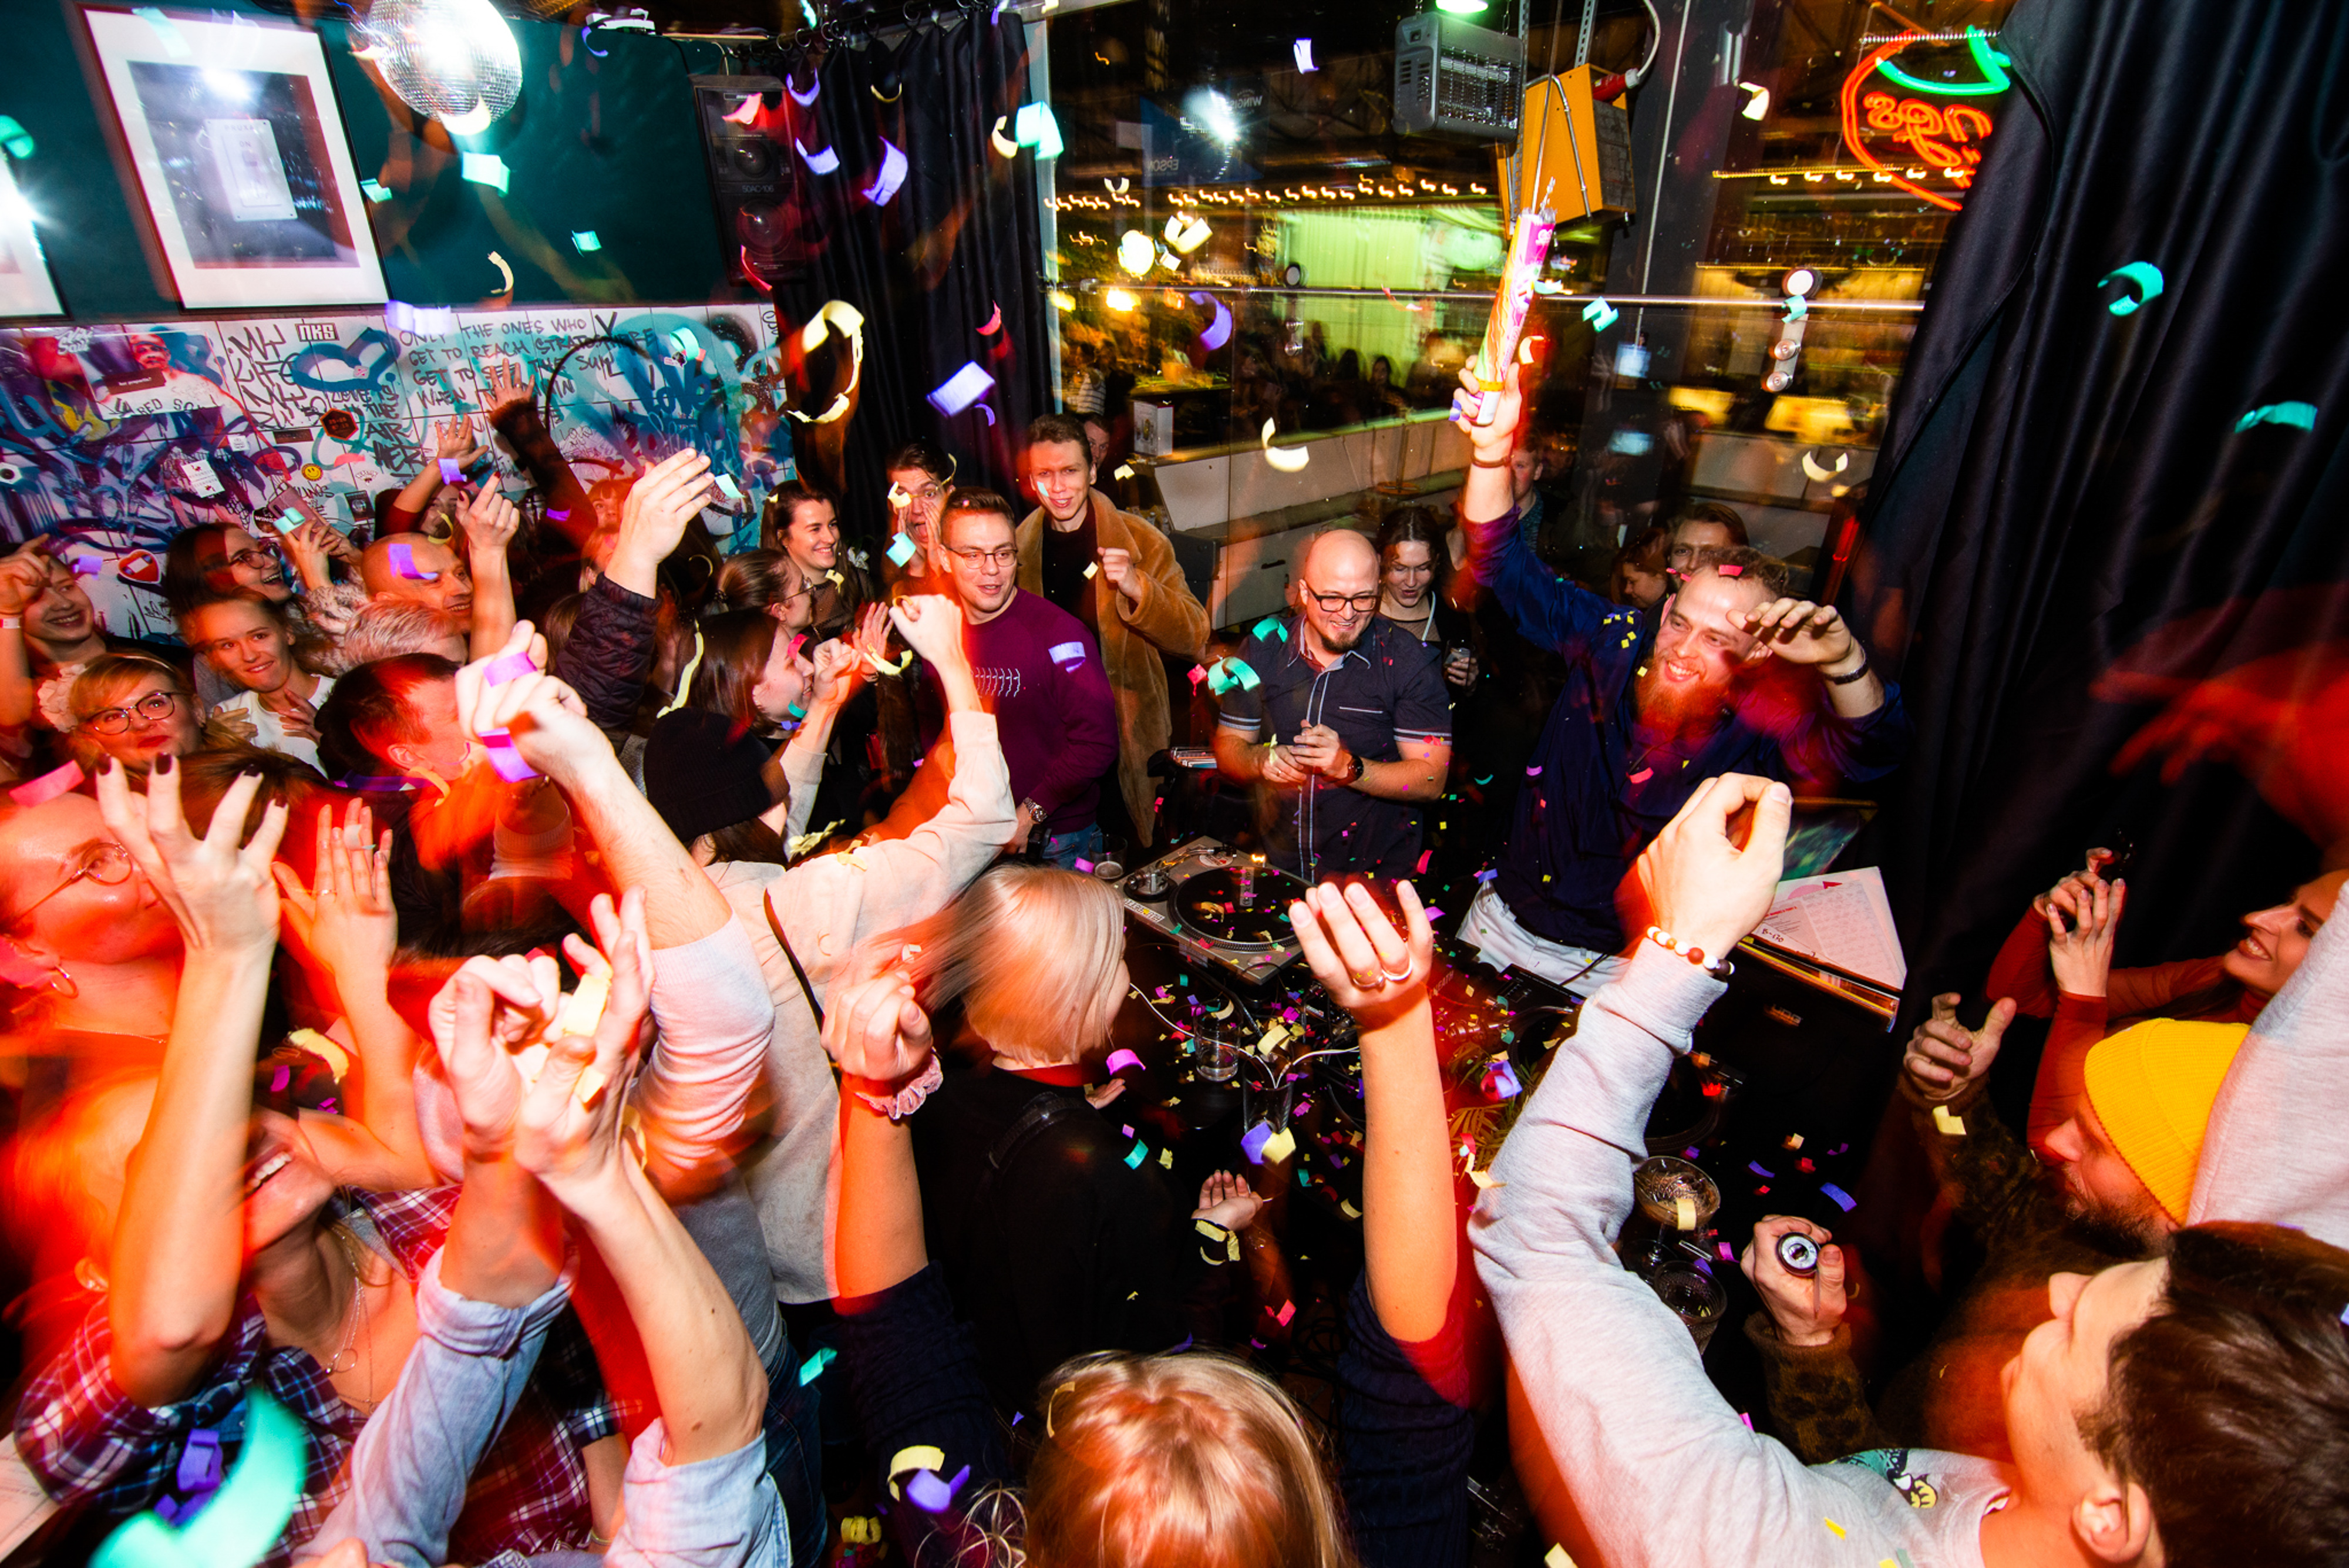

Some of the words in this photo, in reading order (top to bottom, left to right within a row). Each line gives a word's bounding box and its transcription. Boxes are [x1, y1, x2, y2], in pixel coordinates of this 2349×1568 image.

[462, 322, 494, 339] THE
[501, 319, 544, 335] ONES
[550, 318, 587, 333] WHO
[408, 348, 436, 366] GET
[441, 346, 463, 361] TO
[470, 340, 530, 359] REACH
[413, 368, 448, 386] GET
[454, 367, 476, 382] TO
[416, 386, 467, 410] WHEN
